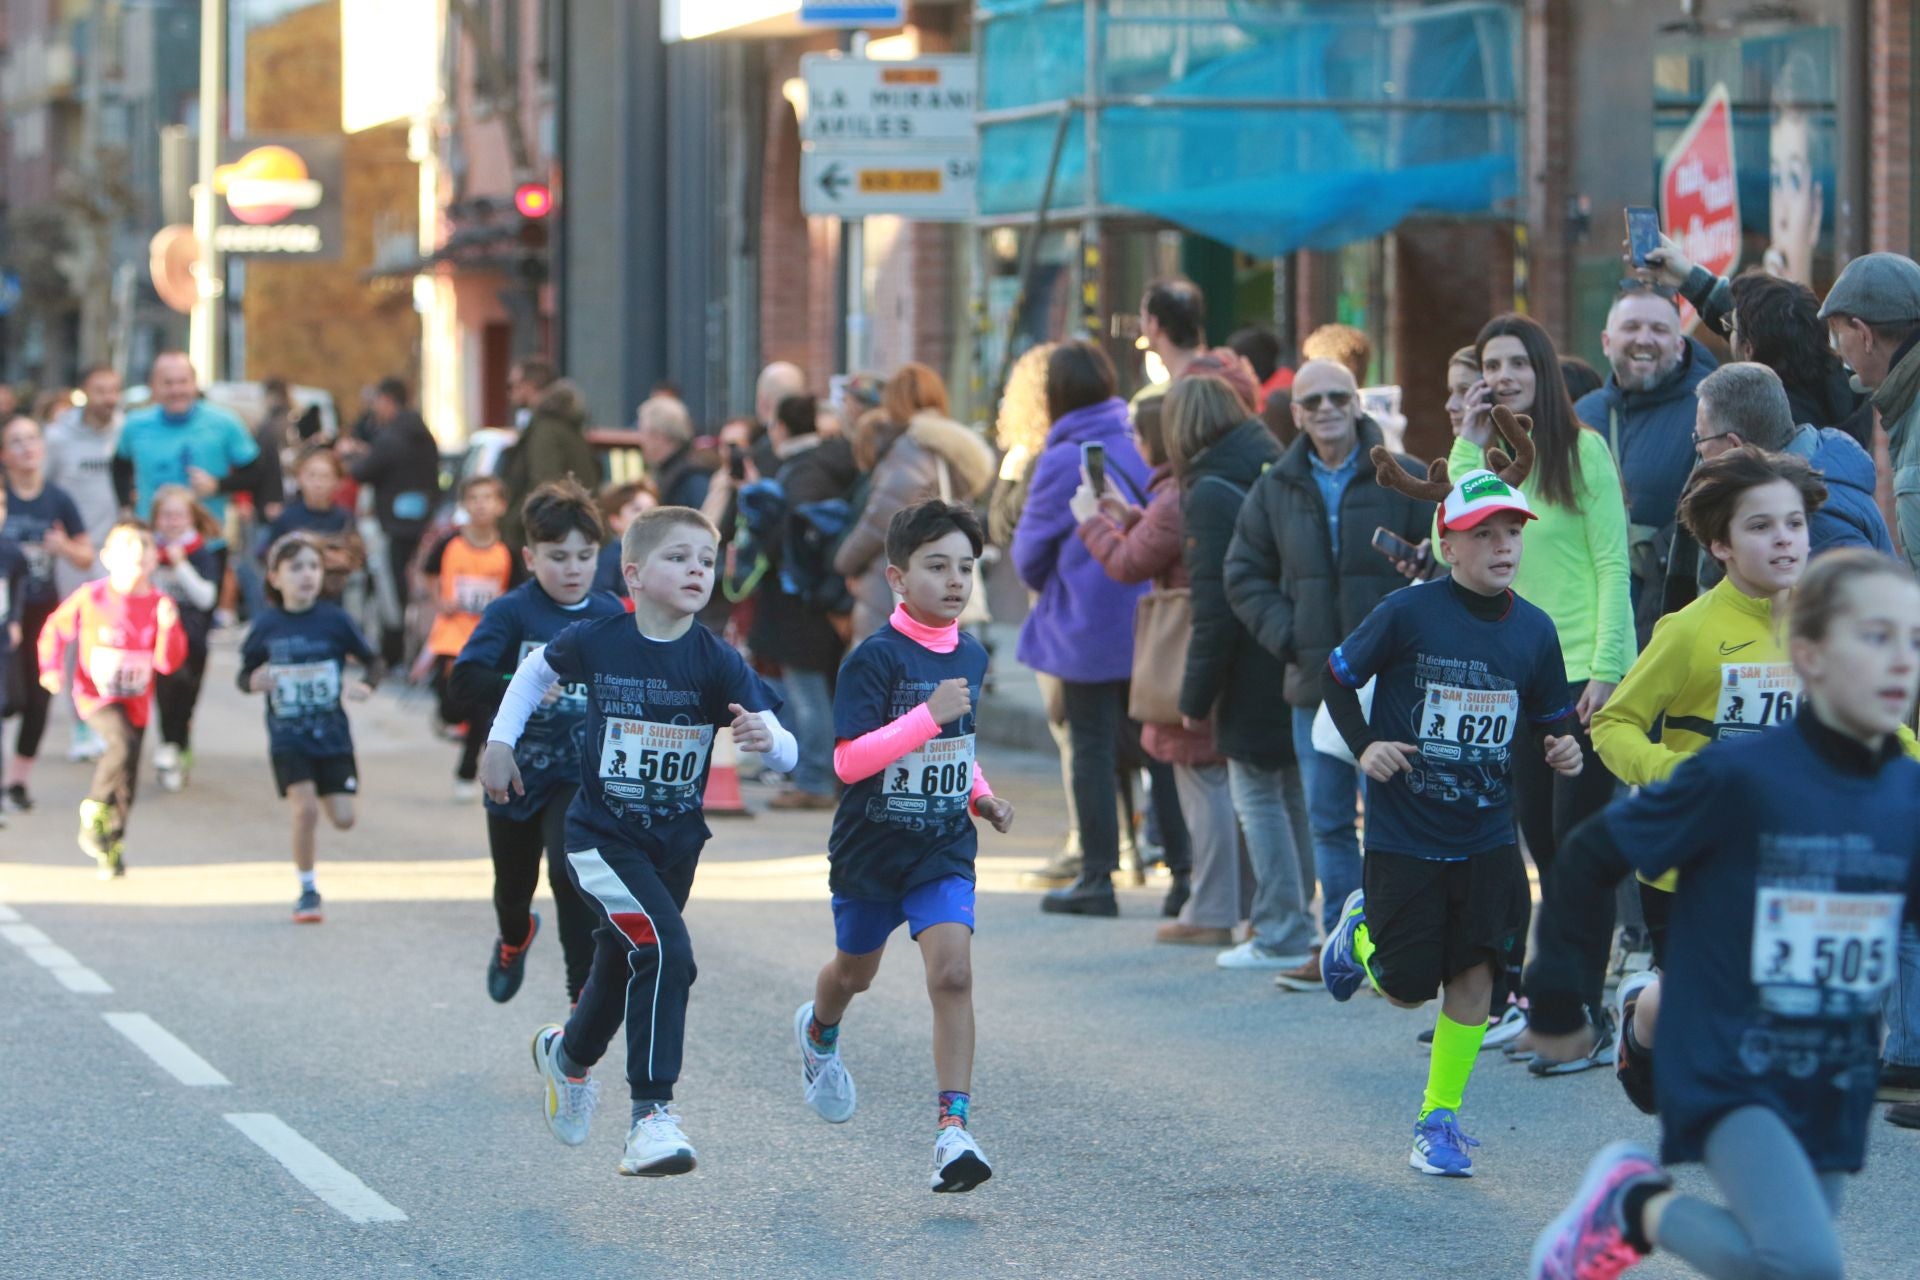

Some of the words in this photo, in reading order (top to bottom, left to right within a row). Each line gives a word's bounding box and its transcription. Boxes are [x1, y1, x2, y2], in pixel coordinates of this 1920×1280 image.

[1426, 655, 1467, 669] diciembre
[1469, 660, 1488, 673] 2024
[594, 673, 602, 684] 31
[604, 674, 644, 687] diciembre
[646, 678, 668, 690] 2024
[622, 686, 645, 703] SAN
[1443, 689, 1463, 701] SAN
[1467, 692, 1511, 704] SILVESTRE
[1459, 703, 1495, 713] LLANERA
[623, 722, 644, 736] SAN
[648, 726, 701, 740] SILVESTRE
[1457, 714, 1508, 745] 620
[641, 737, 683, 749] LLANERA
[1426, 744, 1458, 755] OQUENDO
[638, 749, 698, 783] 560
[921, 761, 968, 796] 608
[607, 783, 641, 794] OQUENDO
[890, 799, 924, 809] OQUENDO
[1814, 937, 1886, 984] 505
